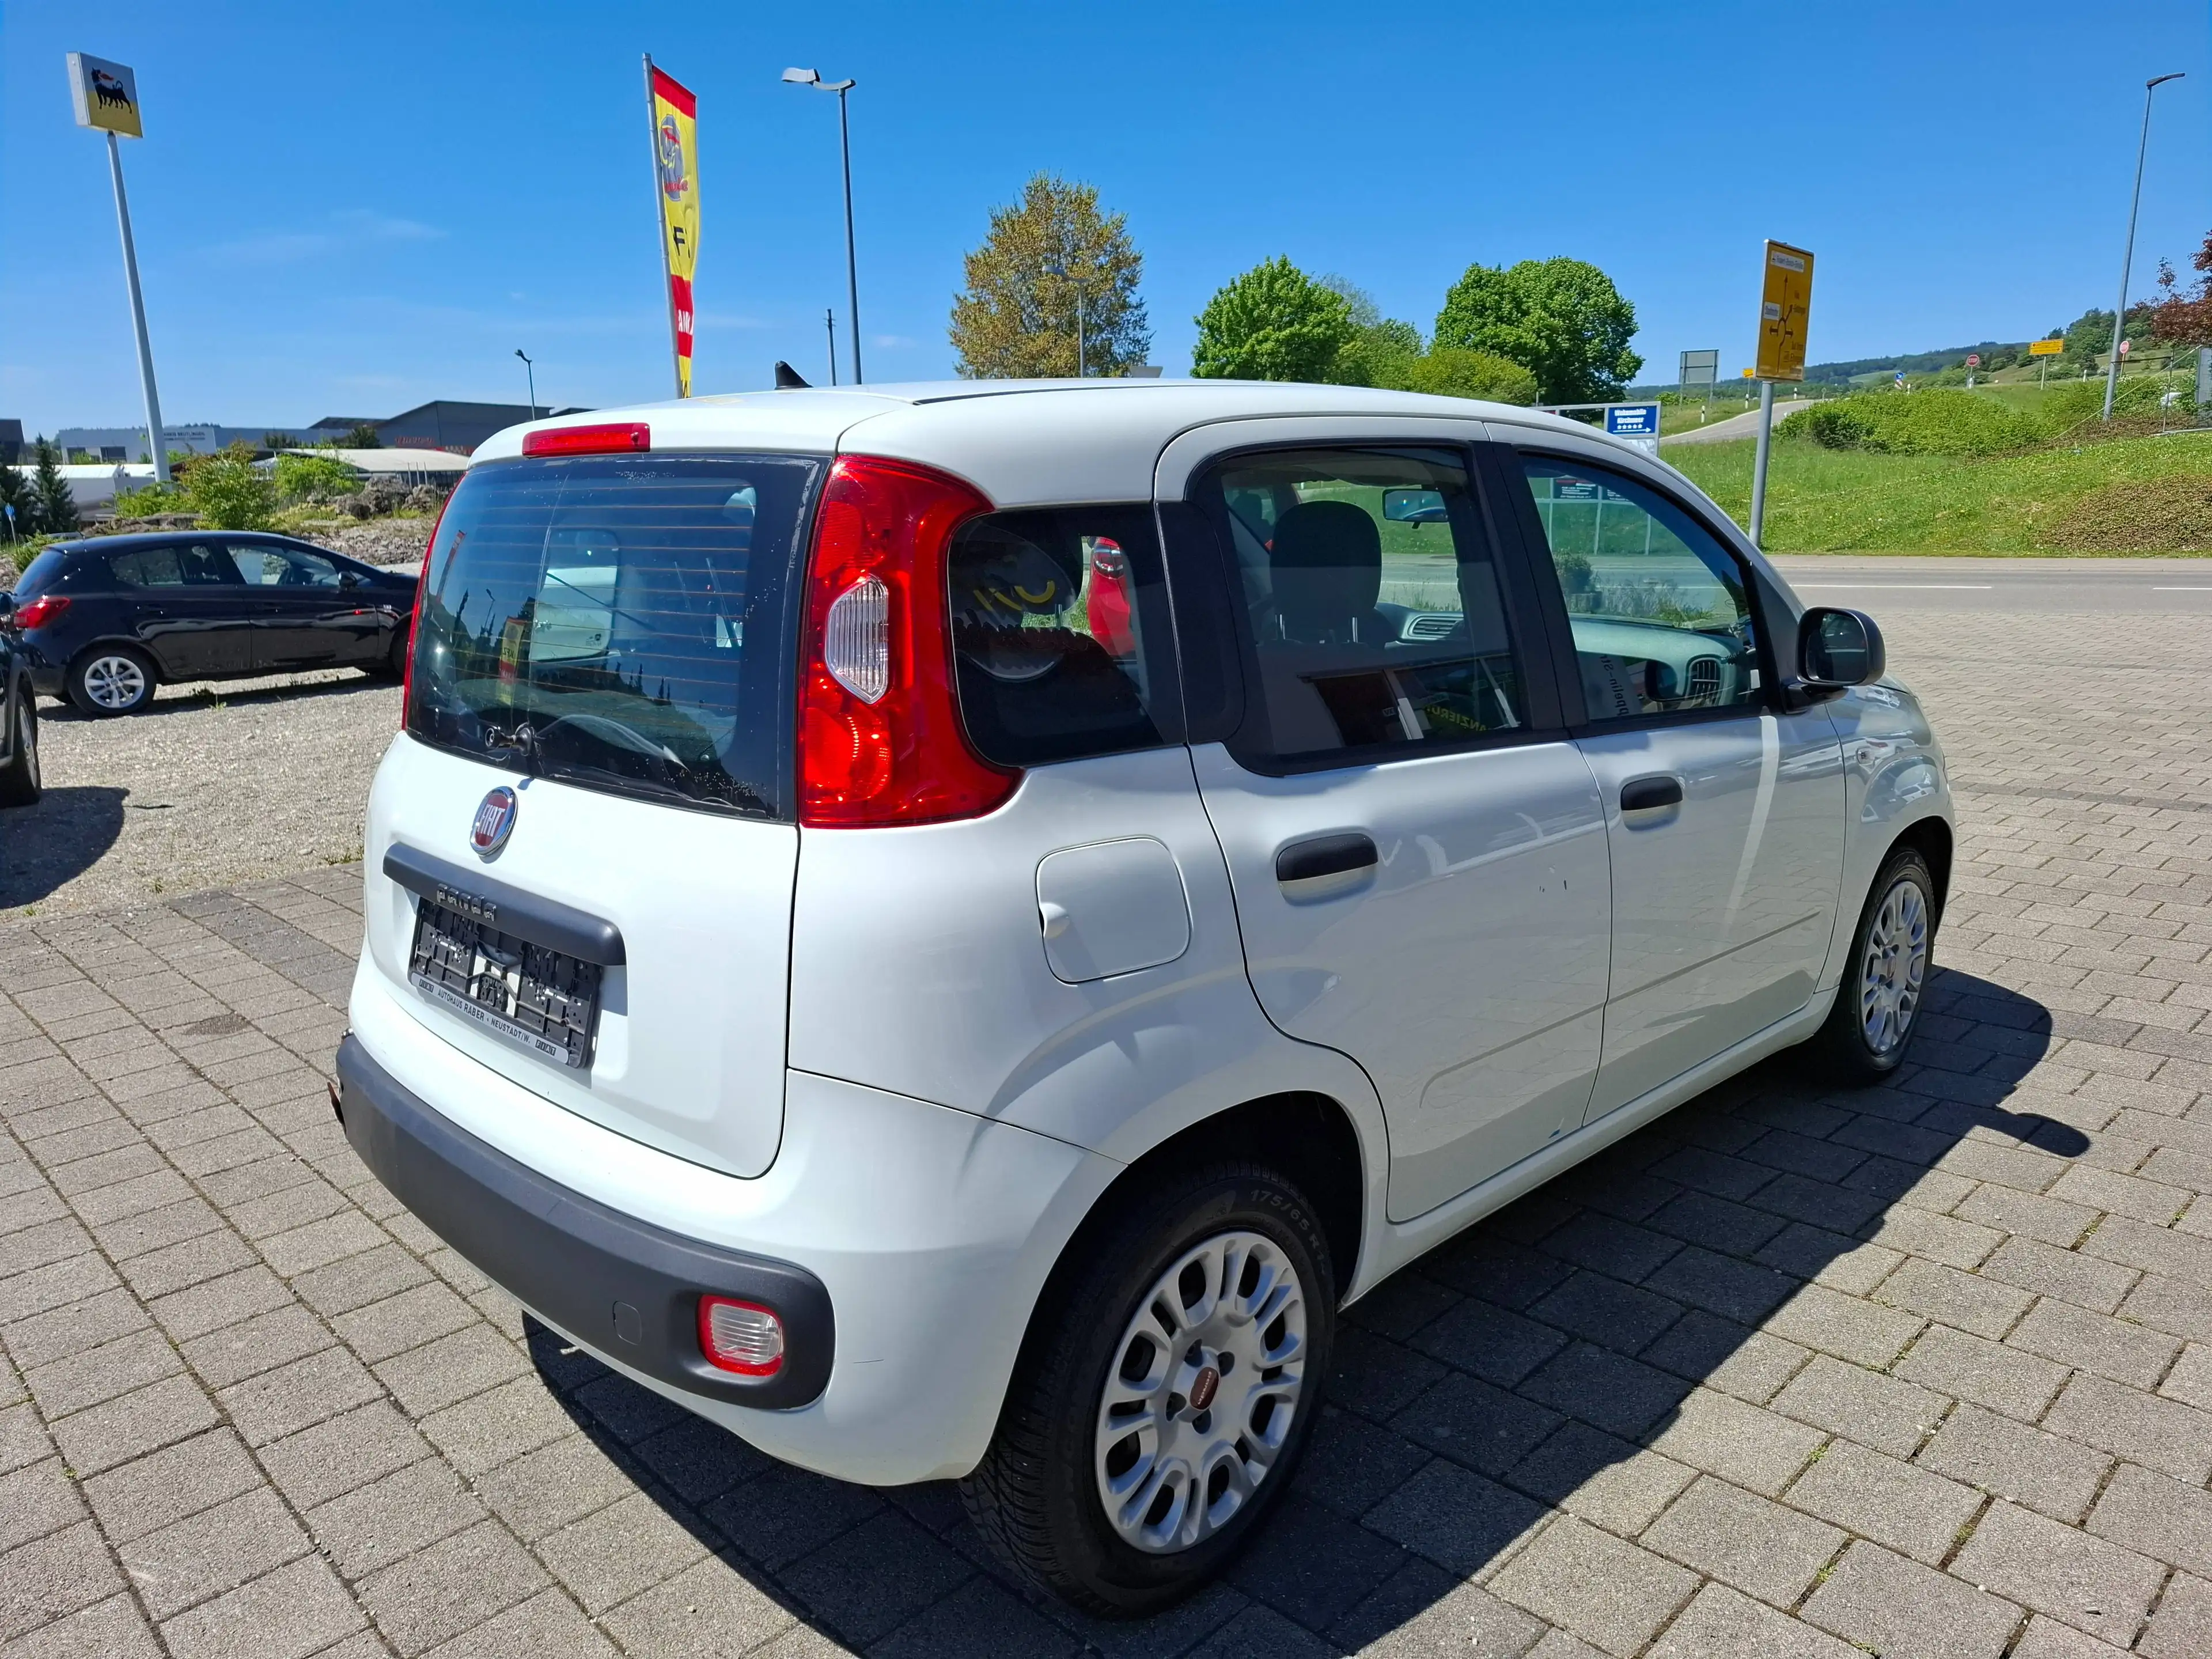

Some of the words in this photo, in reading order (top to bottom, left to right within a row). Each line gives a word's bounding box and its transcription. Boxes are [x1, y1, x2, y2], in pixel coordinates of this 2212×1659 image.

[477, 804, 506, 837] FIAT
[437, 989, 463, 1009] AUTOHAUS
[464, 1003, 485, 1022] RABER
[491, 1018, 531, 1044] NEUSTADT/W.
[535, 1039, 556, 1056] FIAT
[1250, 1189, 1310, 1230] 175/65
